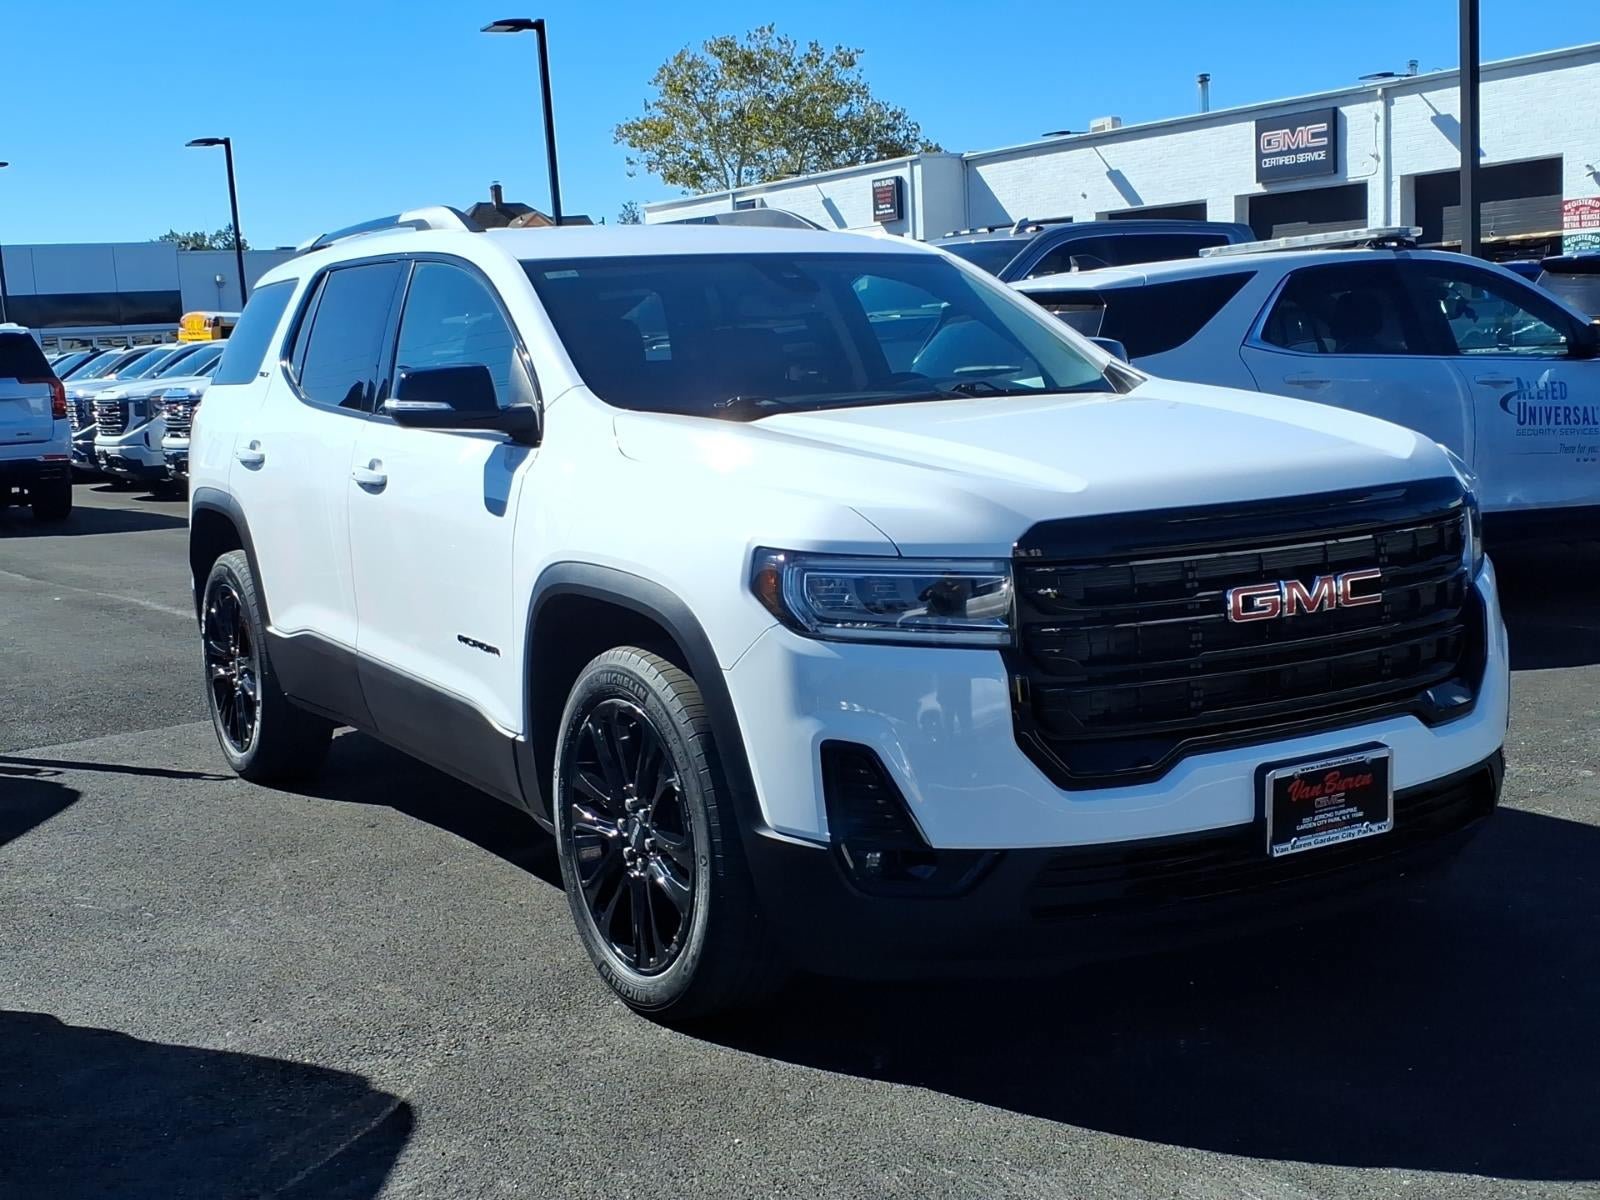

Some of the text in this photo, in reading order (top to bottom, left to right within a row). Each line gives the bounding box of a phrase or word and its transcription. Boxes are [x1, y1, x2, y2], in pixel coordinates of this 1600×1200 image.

[1261, 123, 1328, 153] GMC
[1262, 150, 1327, 168] CERTIFIED SERVICE
[1564, 199, 1600, 211] REGISTERED
[1564, 234, 1600, 246] REGISTERED
[1516, 377, 1568, 400] ALLIED
[1517, 401, 1600, 426] UNIVERSAL
[1516, 427, 1600, 437] SECURITY SERVICES
[1559, 443, 1576, 454] There
[1576, 442, 1586, 455] for
[1227, 568, 1382, 623] GMC
[598, 672, 650, 702] MICHELIN
[1288, 770, 1373, 801] Van Buren
[1296, 821, 1317, 831] GARDEN
[1317, 819, 1328, 827] CITY
[1275, 845, 1289, 855] Van
[1314, 835, 1340, 846] Garden
[1341, 830, 1356, 841] City
[1376, 823, 1388, 832] NY
[600, 963, 648, 1003] MICHELIN
